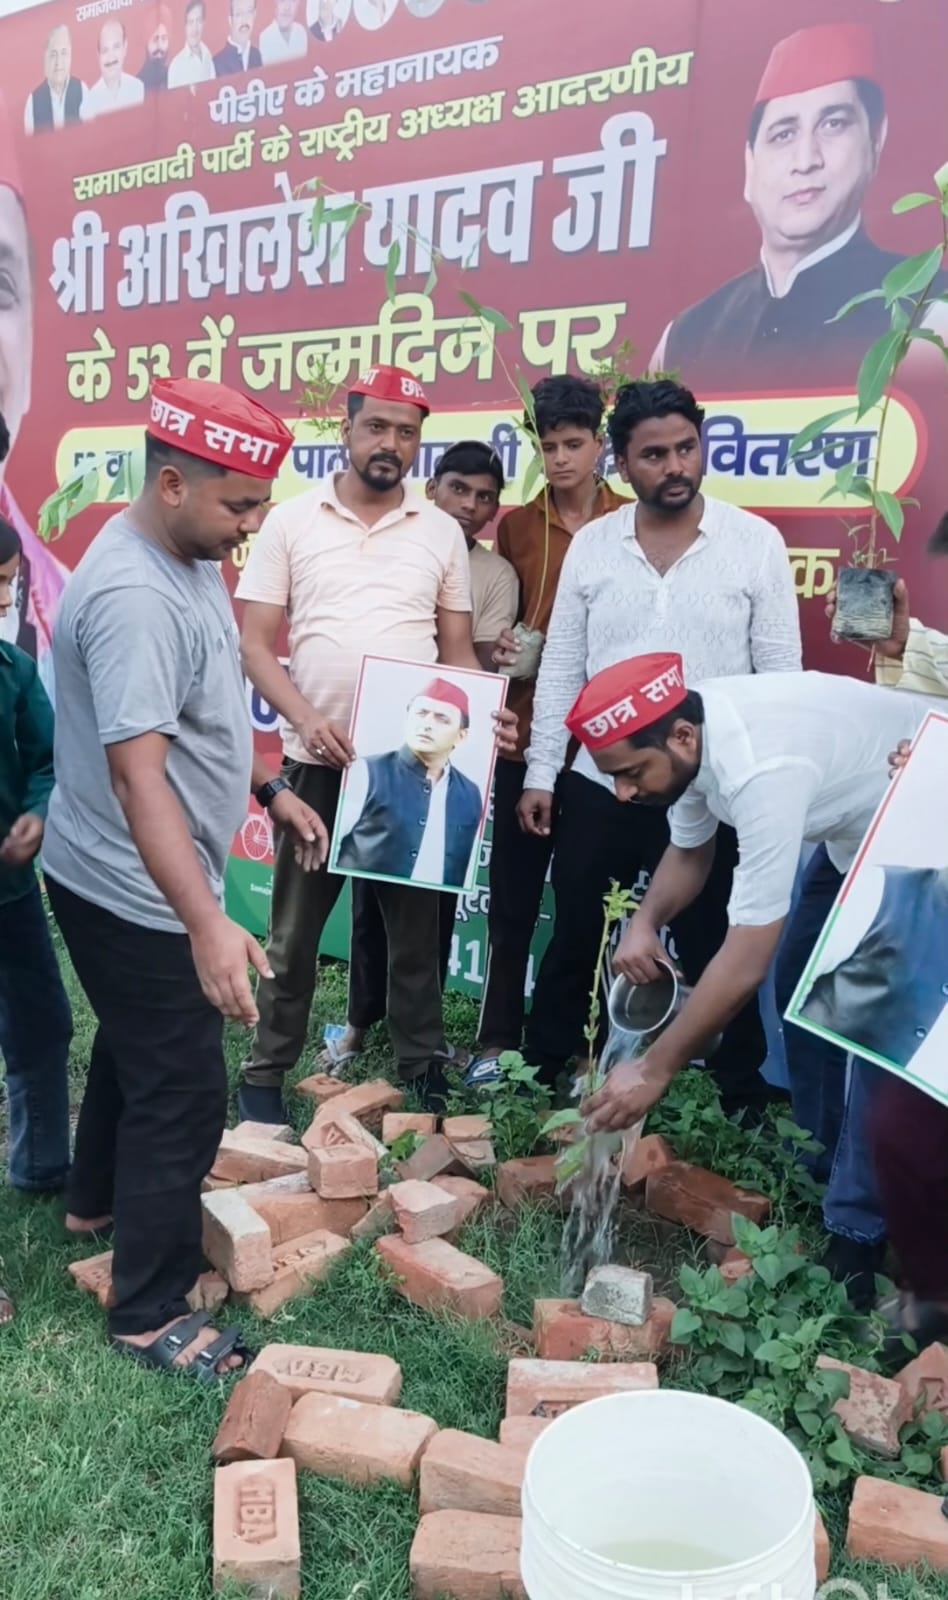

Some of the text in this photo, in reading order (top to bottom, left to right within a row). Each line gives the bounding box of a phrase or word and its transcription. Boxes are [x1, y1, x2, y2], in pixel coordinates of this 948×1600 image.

[73, 47, 693, 200] समाजवादी पार्टी के राष्ट्रीय अध्यक्ष आदरणीय
[209, 36, 502, 125] पीडीए के महानायक
[49, 111, 667, 313] श्री अखिलेश यादव जी
[66, 292, 626, 403] के 53 वें जन्मदिन पर
[151, 394, 280, 466] छात्र सभा
[702, 415, 878, 477] वितरण
[581, 695, 639, 738] छात्र
